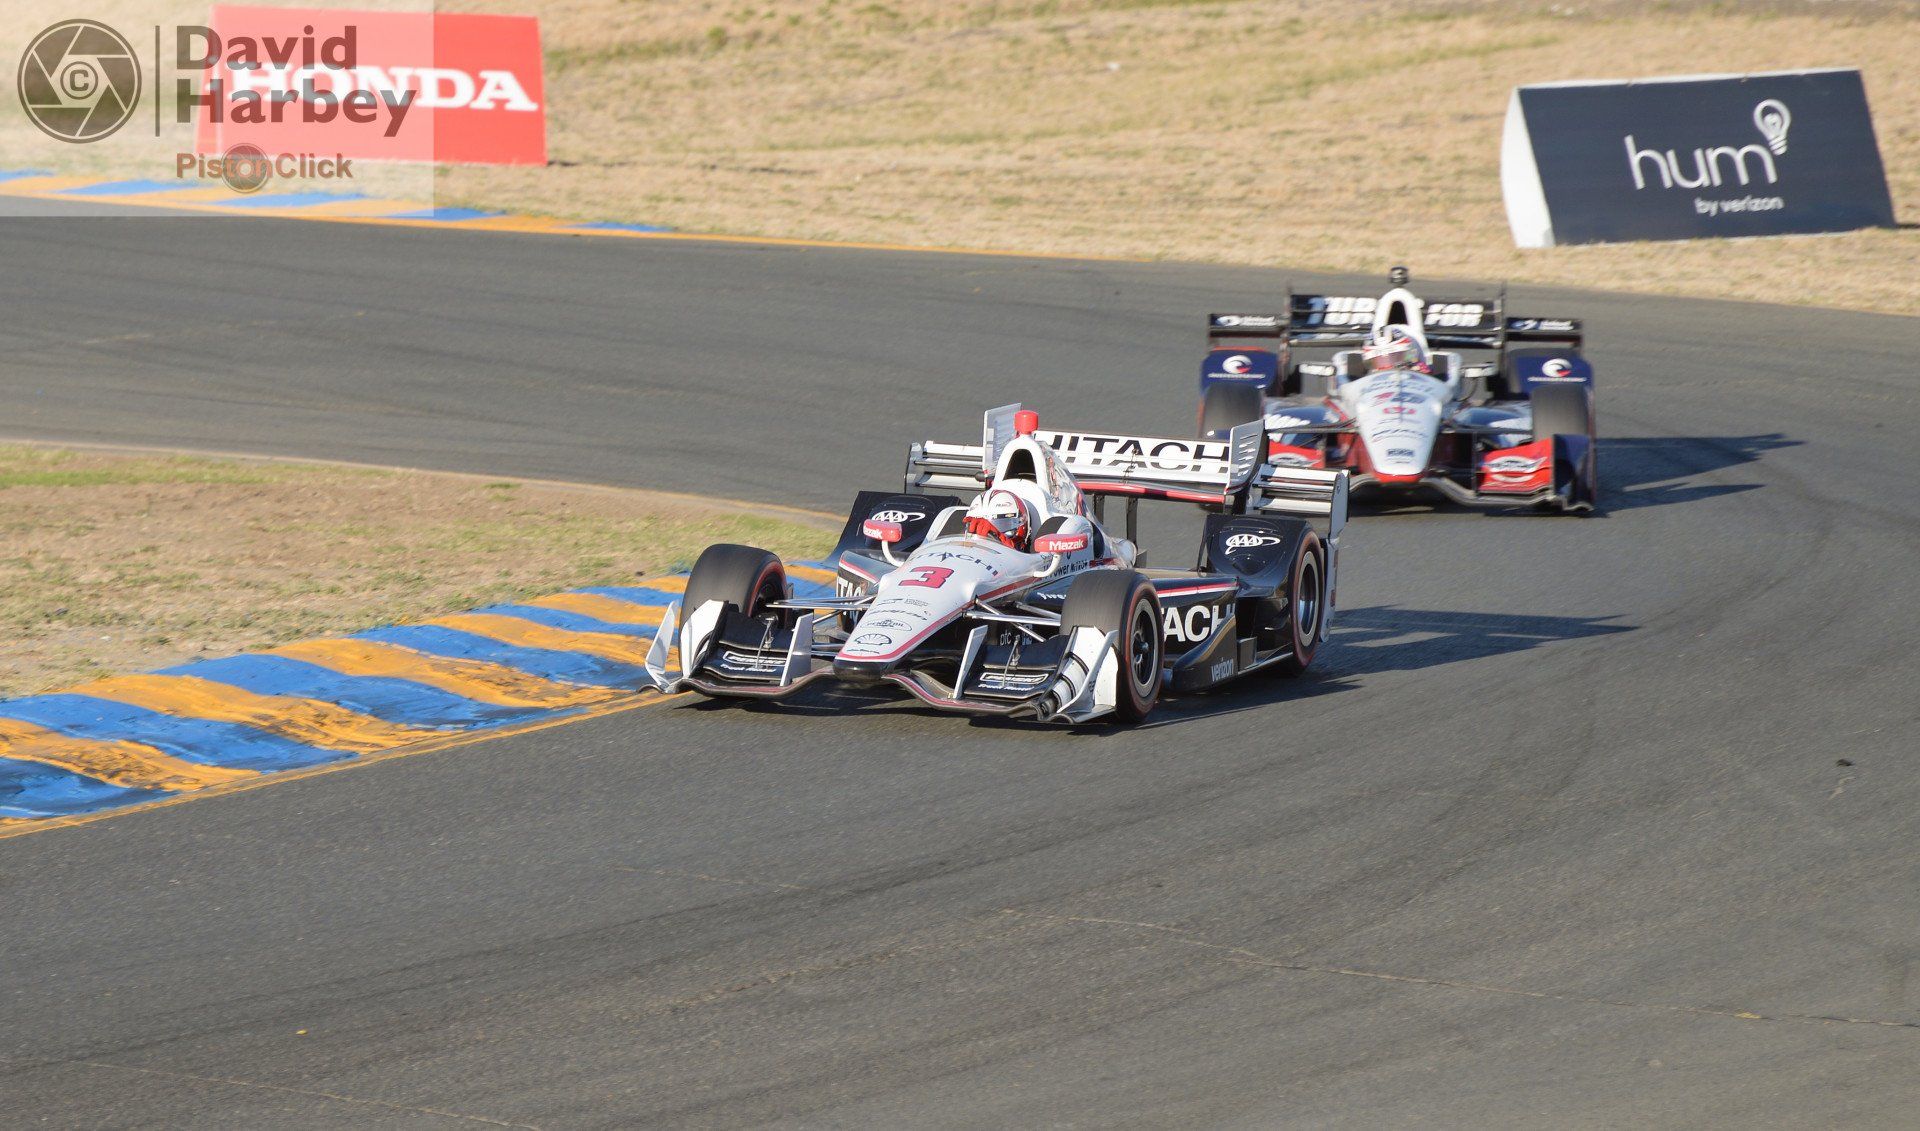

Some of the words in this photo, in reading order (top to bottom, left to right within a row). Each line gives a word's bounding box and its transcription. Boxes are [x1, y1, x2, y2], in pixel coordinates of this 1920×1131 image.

[226, 62, 538, 112] HONDA
[1624, 135, 1777, 190] hum
[1695, 197, 1718, 216] by
[1719, 195, 1785, 214] verizon
[1049, 539, 1084, 551] Mazak
[1227, 534, 1263, 547] AAA
[898, 566, 954, 589] 3
